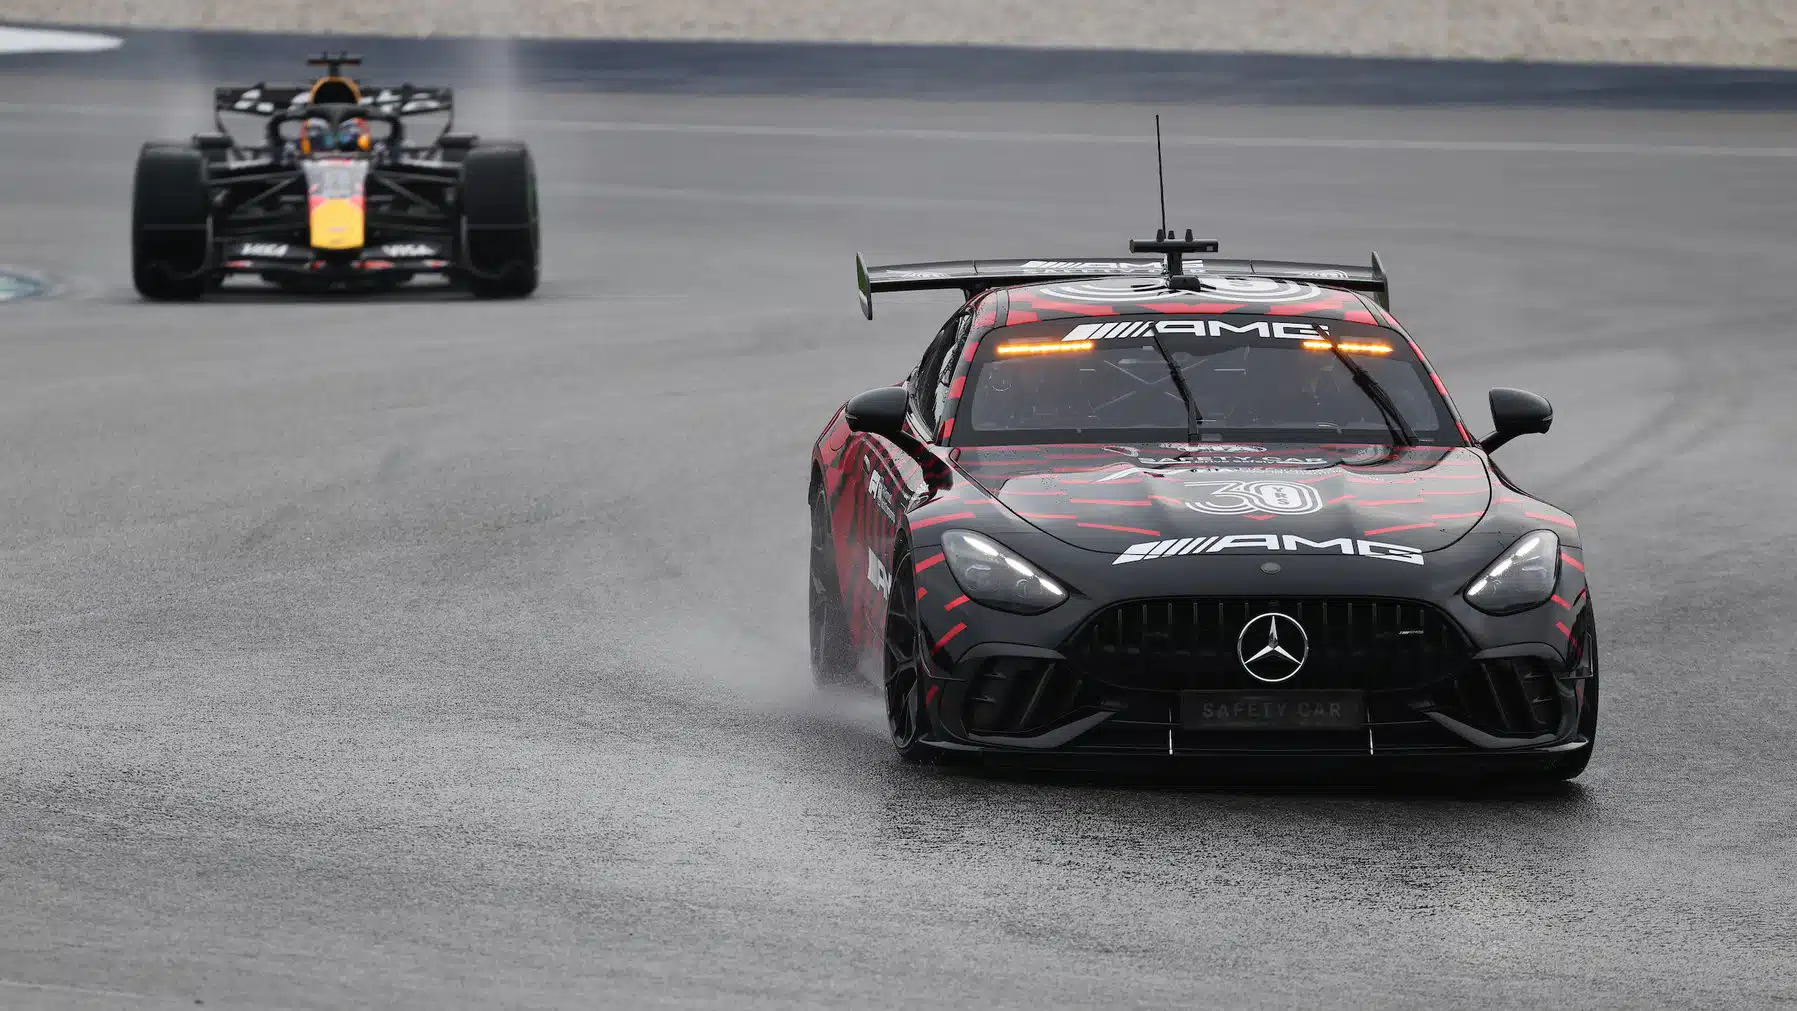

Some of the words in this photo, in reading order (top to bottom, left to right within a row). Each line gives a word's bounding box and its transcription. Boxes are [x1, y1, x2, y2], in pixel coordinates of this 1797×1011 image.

[1143, 320, 1330, 341] AMG
[1184, 480, 1323, 515] 30
[1271, 487, 1290, 505] YRS
[1205, 534, 1425, 565] AMG
[1203, 702, 1287, 718] SAFETY
[1298, 702, 1341, 718] CAR
